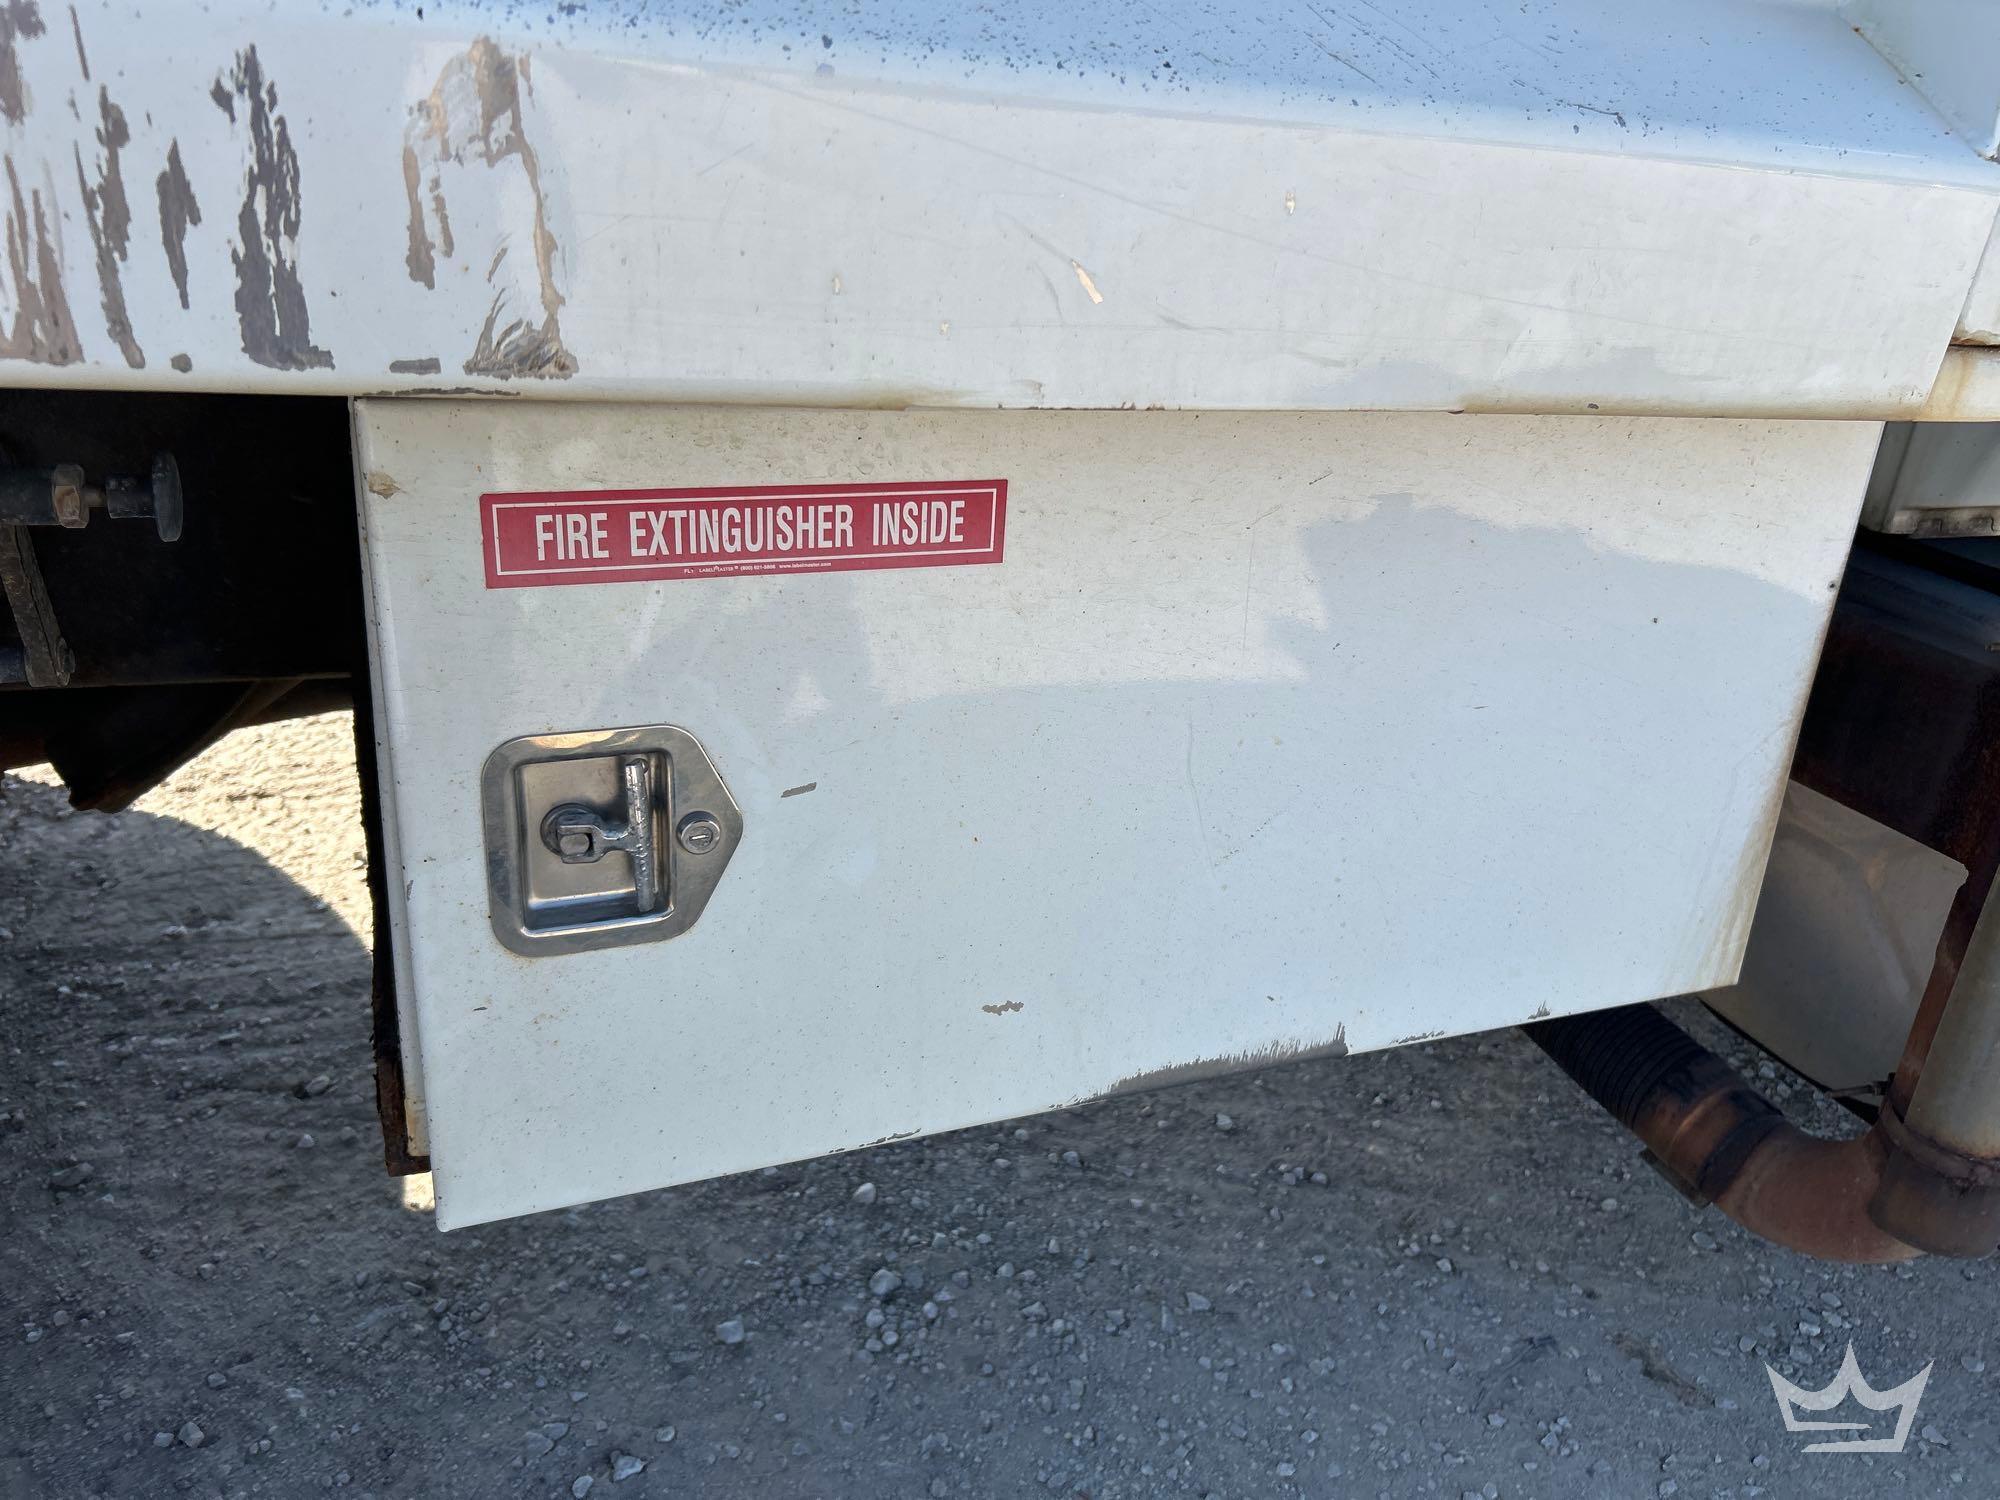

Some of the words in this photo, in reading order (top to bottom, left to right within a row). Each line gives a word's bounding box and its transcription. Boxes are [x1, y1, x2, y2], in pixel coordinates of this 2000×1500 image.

[535, 512, 610, 561] FIRE
[629, 504, 853, 557] EXTINGUISHER
[872, 500, 965, 546] INSIDE
